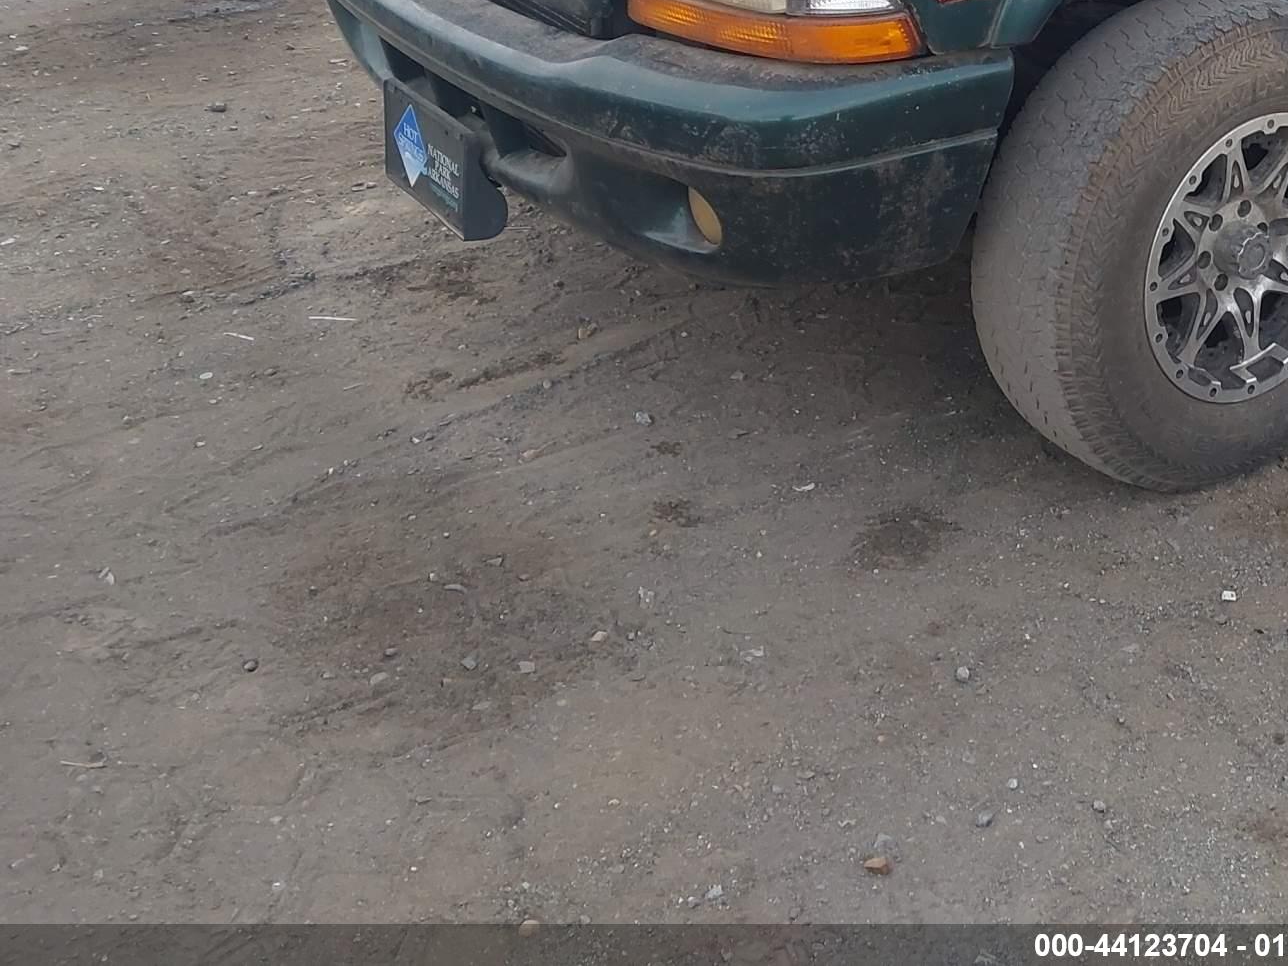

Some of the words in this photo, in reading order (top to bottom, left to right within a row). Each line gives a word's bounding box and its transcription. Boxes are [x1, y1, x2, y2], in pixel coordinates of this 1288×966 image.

[403, 122, 419, 144] HOT
[427, 143, 460, 177] NATIONAL
[434, 160, 452, 182] PARK
[428, 166, 460, 200] ARKANSAS
